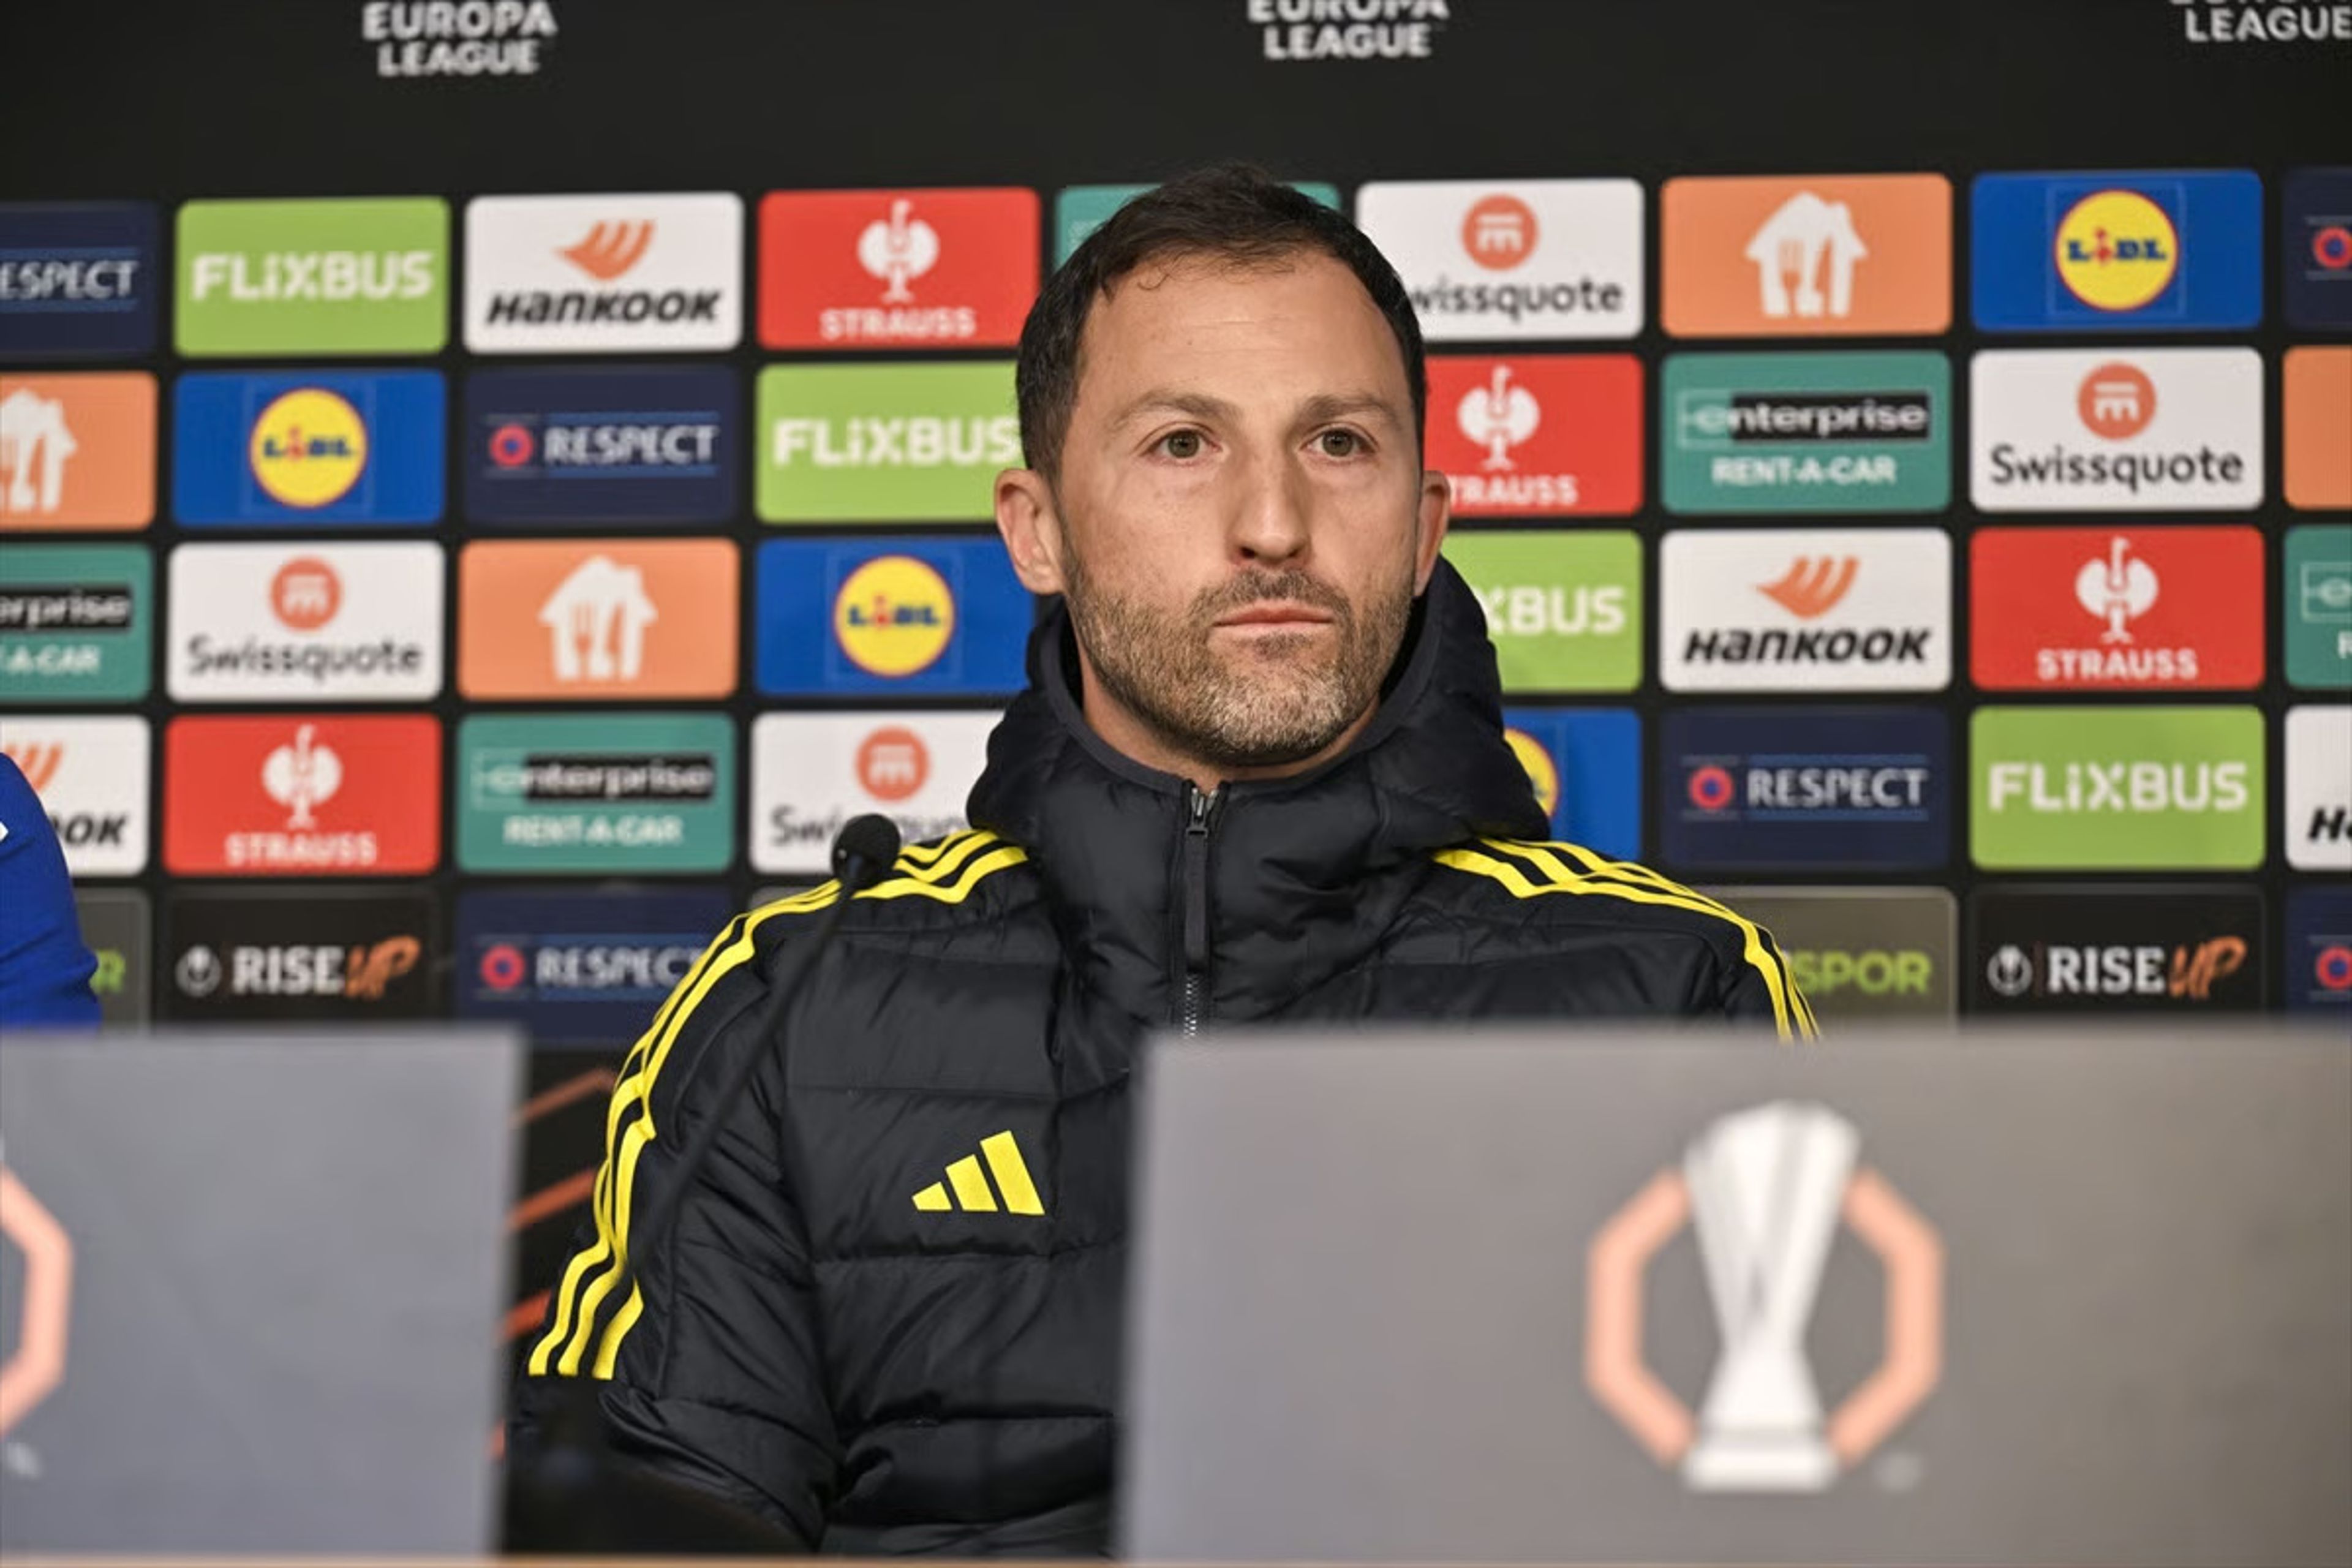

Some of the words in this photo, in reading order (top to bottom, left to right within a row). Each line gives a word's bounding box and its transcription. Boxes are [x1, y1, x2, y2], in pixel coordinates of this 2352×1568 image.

[363, 0, 557, 40] EUROPA
[2185, 7, 2352, 42] LEAGUE
[377, 40, 539, 76] LEAGUE
[1264, 23, 1431, 59] LEAGUE
[0, 260, 137, 300] ESPECT
[1413, 276, 1624, 322] wissquote
[820, 306, 976, 341] STRAUSS
[1694, 399, 1928, 437] enterprise
[544, 424, 717, 464] RESPECT
[1711, 455, 1897, 486] RENT-A-CAR
[1990, 443, 2244, 494] Swissquote
[1449, 475, 1578, 505] TRAUSS
[1472, 586, 1626, 635] XBUS
[186, 634, 423, 682] Swissquote
[2037, 647, 2198, 680] STRAUSS
[489, 759, 715, 799] enterprise
[1747, 767, 1926, 808] RESPECT
[224, 832, 378, 867] STRAUSS
